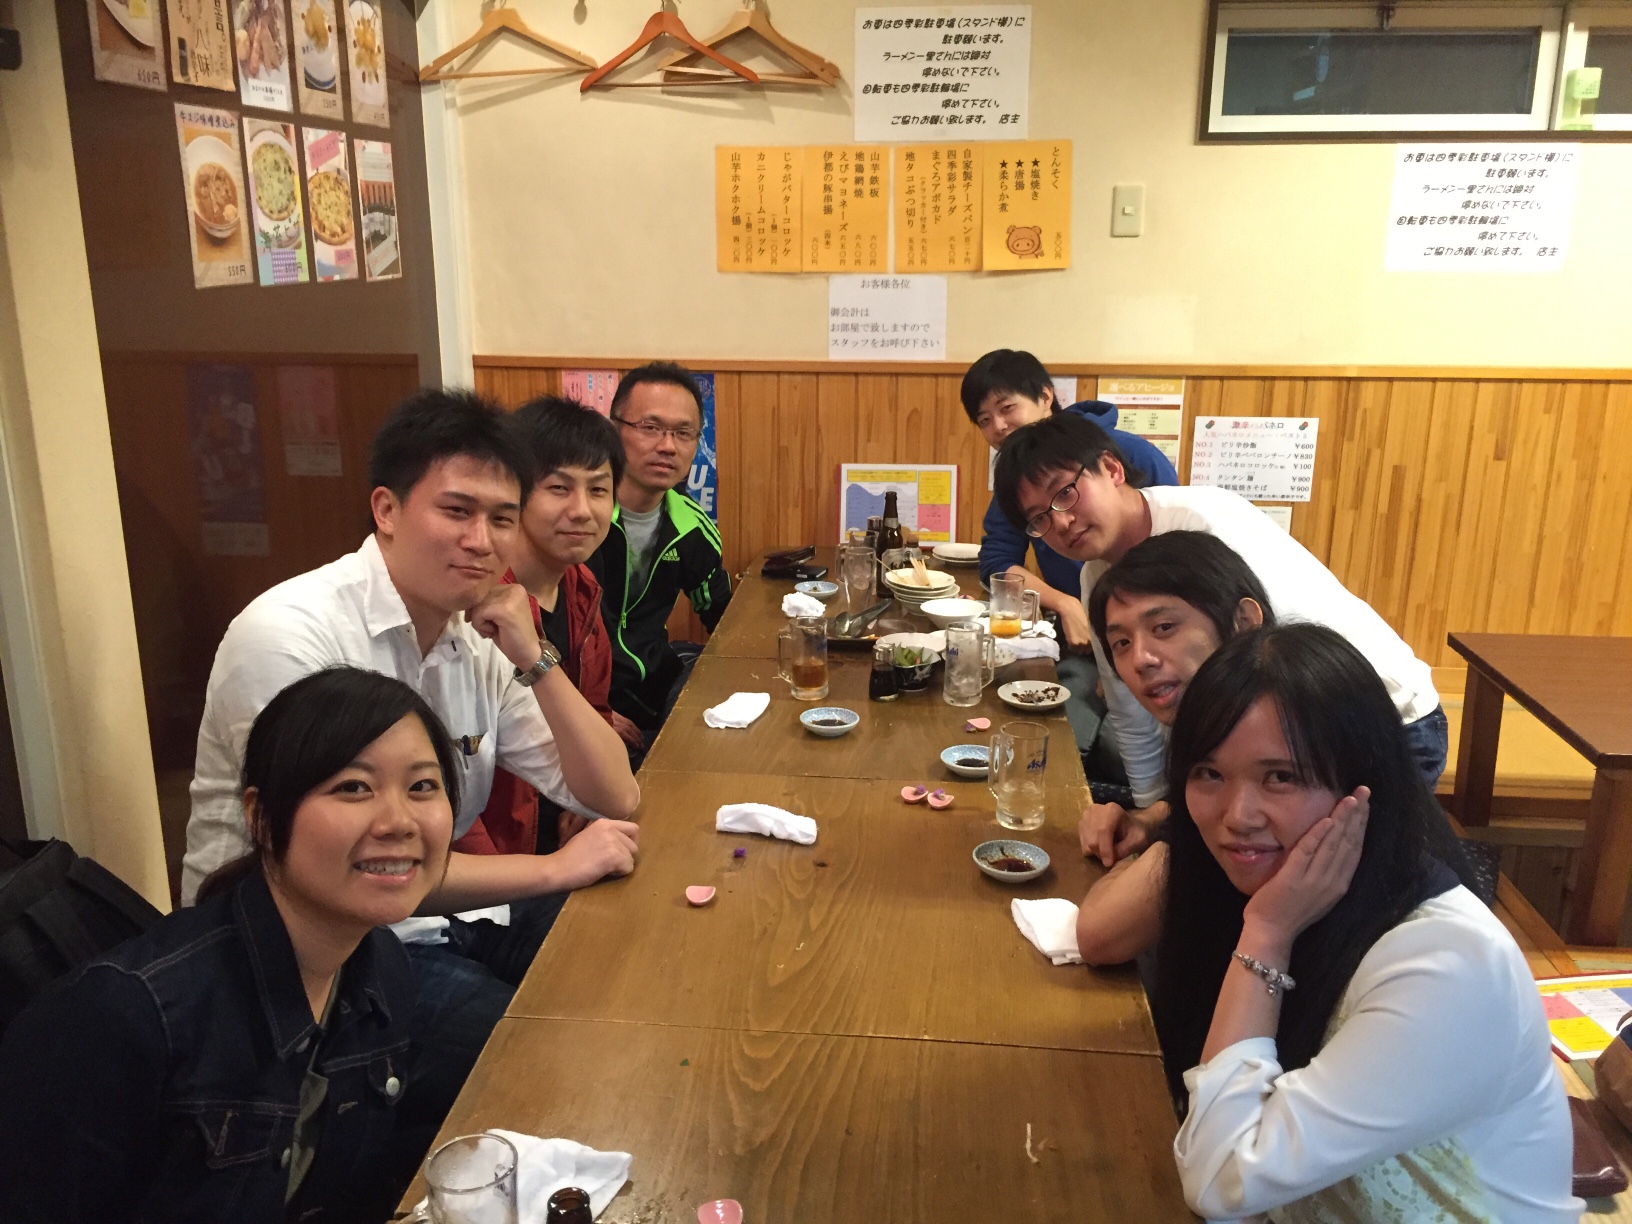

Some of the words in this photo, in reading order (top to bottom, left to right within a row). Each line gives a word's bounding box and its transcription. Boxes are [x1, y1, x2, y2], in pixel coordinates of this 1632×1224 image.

[942, 34, 1004, 45] 駐車願います。
[922, 67, 1000, 78] 停めないで下さい。
[891, 115, 987, 125] ご協力お願い致します。
[999, 114, 1021, 124] 店主
[941, 99, 1000, 109] 停めて下さい。
[869, 151, 880, 198] 山芋鉄板
[931, 150, 941, 225] まぐろアボカド
[947, 149, 957, 217] 四季彩サラダ
[1051, 146, 1061, 190] とんそく
[757, 152, 766, 257] カニクリームコロッケ
[782, 152, 792, 257] じゃがバターコロッケ
[839, 151, 848, 232] えびマヨネーズ
[905, 151, 916, 229] 地タコぶつ切り
[962, 148, 973, 235] 自家製チーズパン
[999, 170, 1009, 213] 柔らか煮
[861, 278, 911, 289] お客様各位
[830, 307, 870, 317] 御会計は
[830, 323, 931, 332] お部屋で致しますので
[831, 338, 940, 348] スタッフをお呼び下さい
